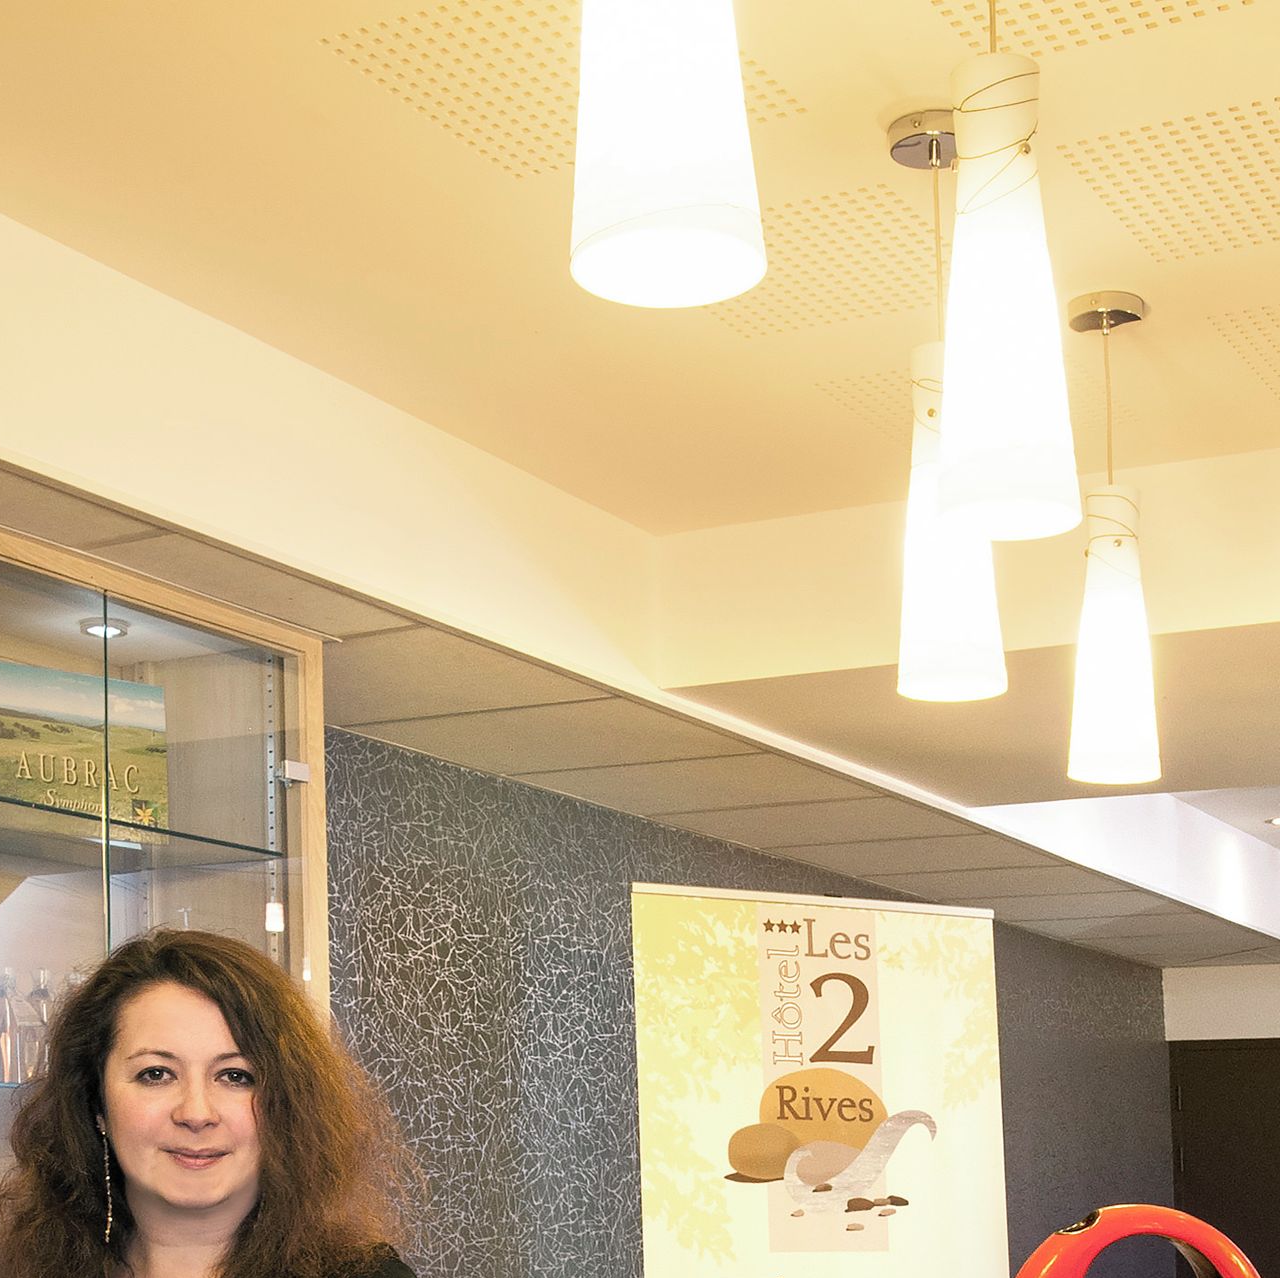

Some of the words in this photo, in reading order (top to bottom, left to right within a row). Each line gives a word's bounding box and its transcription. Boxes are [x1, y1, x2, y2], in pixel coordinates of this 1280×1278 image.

[17, 750, 141, 794] AUBRAC
[803, 918, 872, 961] Les
[766, 945, 804, 1066] Hôtel
[809, 972, 875, 1065] 2
[775, 1085, 875, 1123] Rives
